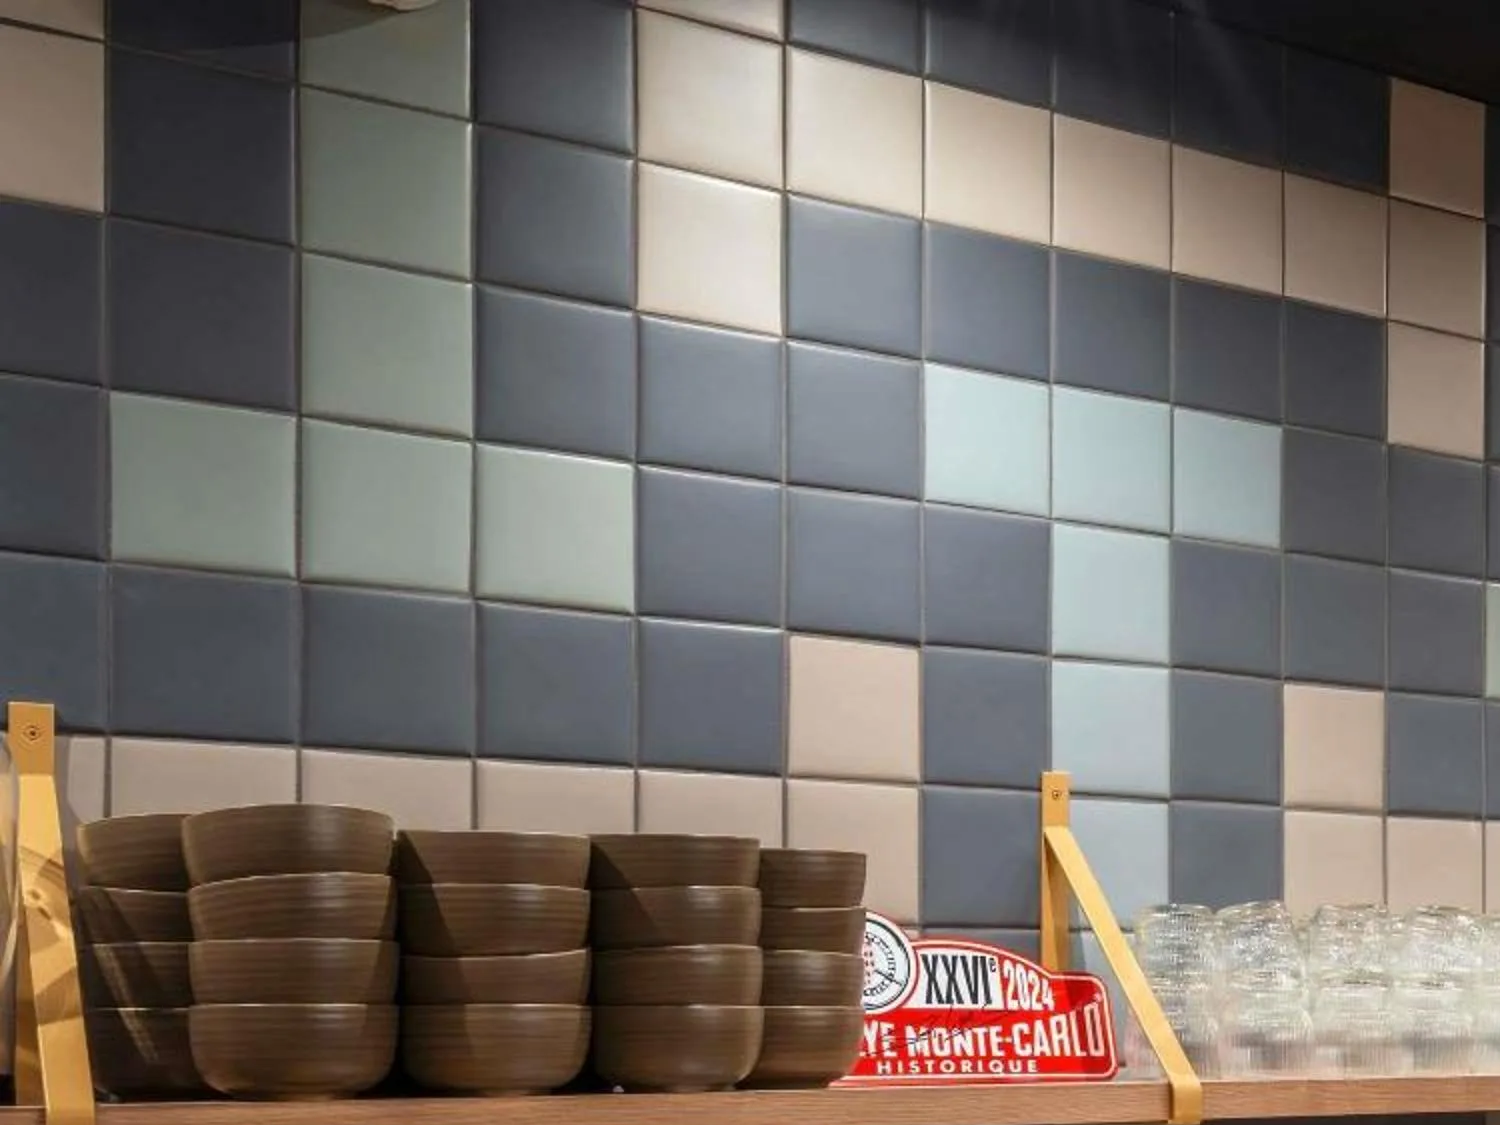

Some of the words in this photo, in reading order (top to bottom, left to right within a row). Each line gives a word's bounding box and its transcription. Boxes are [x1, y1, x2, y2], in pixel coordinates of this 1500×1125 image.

[1003, 959, 1056, 1012] 2024
[860, 1019, 897, 1057] YE
[904, 1001, 1106, 1057] MONTE-CARLO
[876, 1059, 1039, 1074] HISTORIQUE
